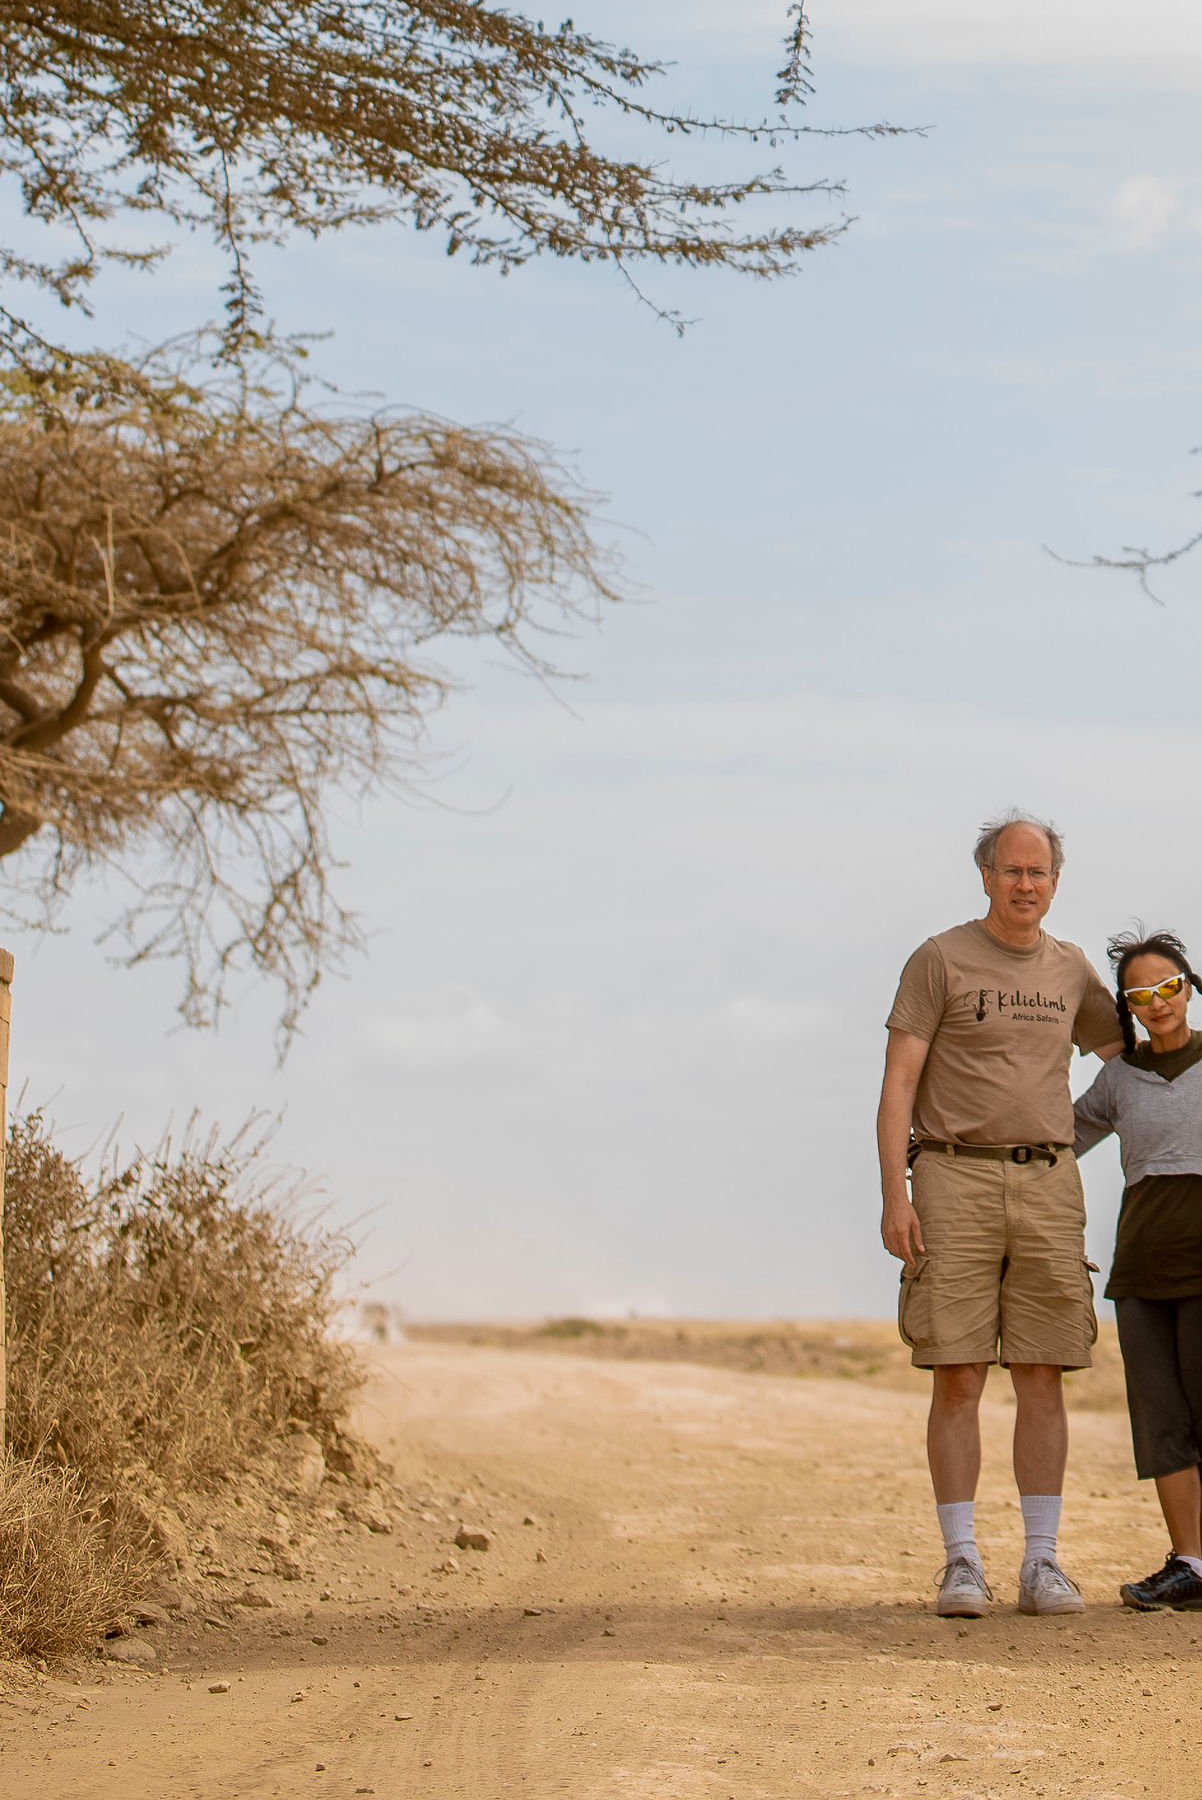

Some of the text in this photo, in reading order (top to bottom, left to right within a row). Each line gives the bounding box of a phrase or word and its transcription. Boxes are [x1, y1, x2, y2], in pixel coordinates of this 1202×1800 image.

[998, 990, 1066, 1012] Kiliclimb
[1012, 1013, 1059, 1024] Africa Safaris
